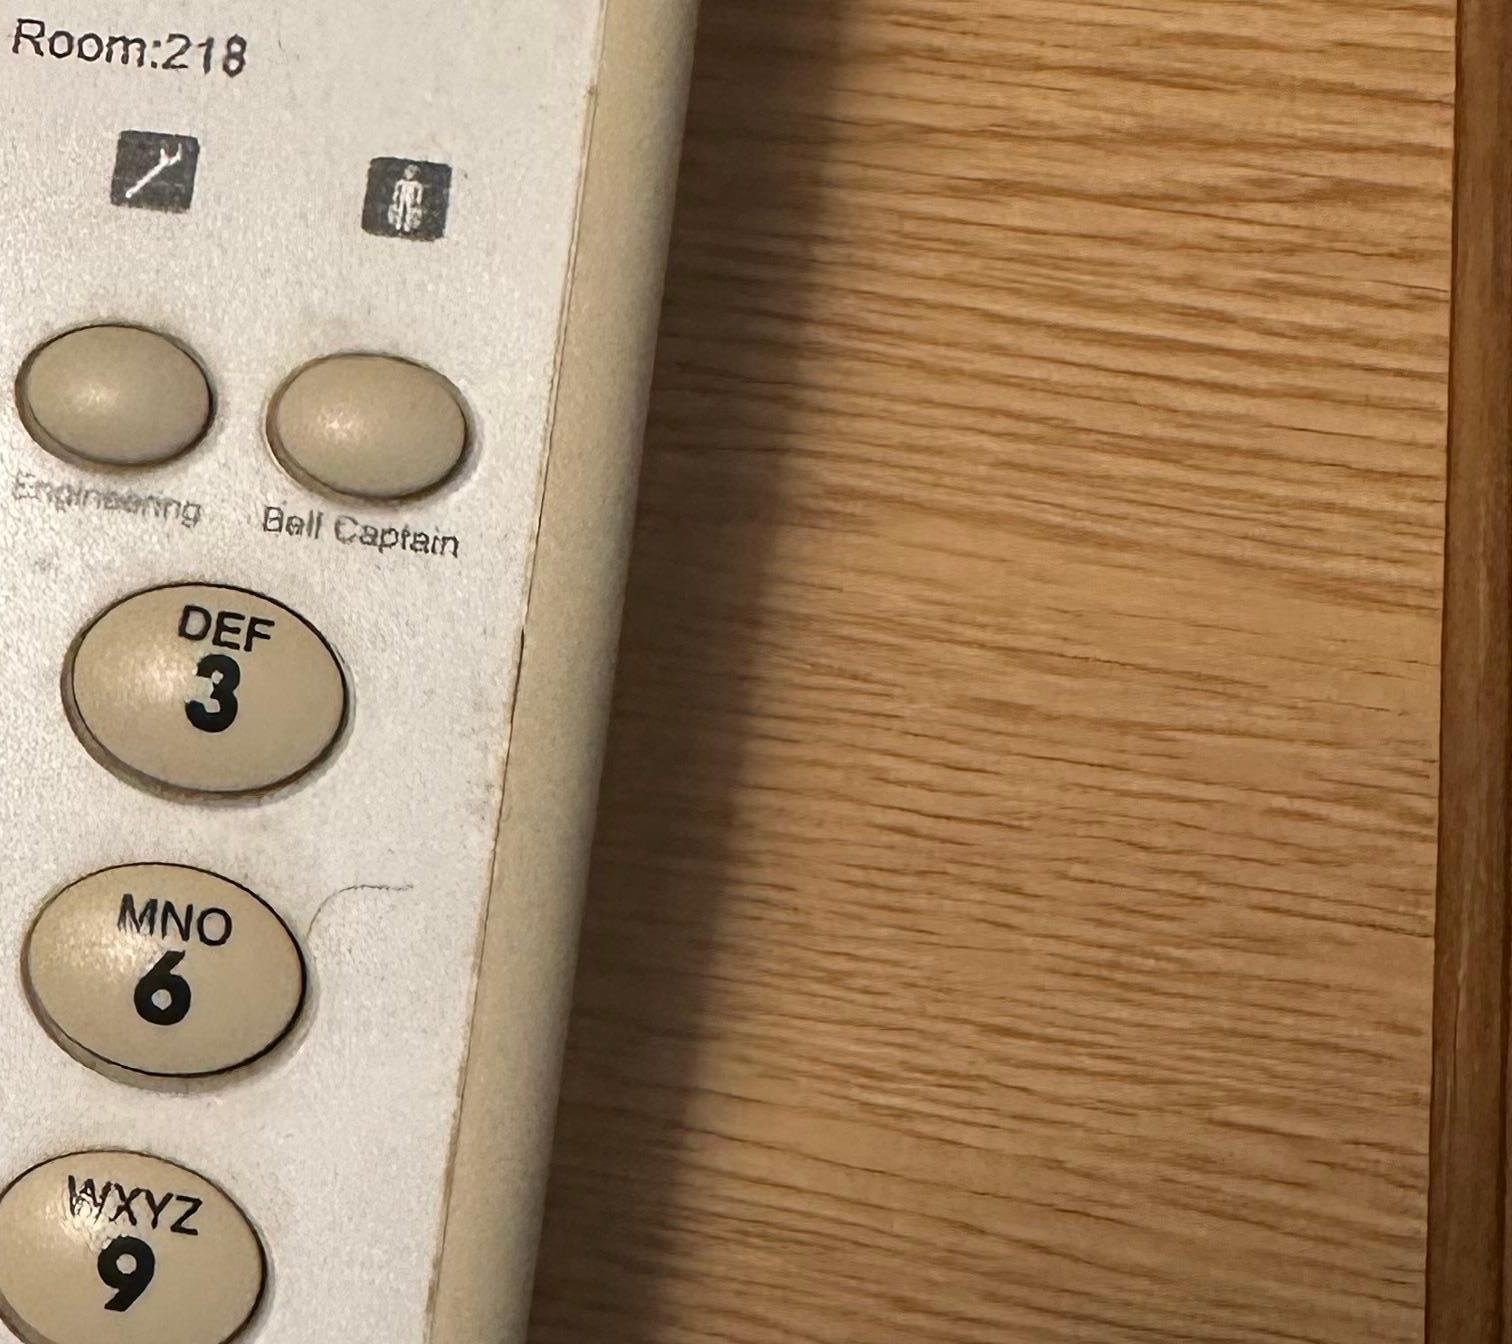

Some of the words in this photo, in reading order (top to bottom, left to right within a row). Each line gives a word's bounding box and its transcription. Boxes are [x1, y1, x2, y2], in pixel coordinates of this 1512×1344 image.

[13, 17, 247, 77] Room:218
[263, 506, 322, 540] Bell
[335, 515, 459, 557] Captain
[178, 605, 276, 652] DEF
[184, 653, 240, 733] 3
[117, 893, 232, 947] MNO
[133, 950, 192, 1026] 6
[68, 1175, 202, 1236] WXYZ
[97, 1235, 155, 1313] 9
